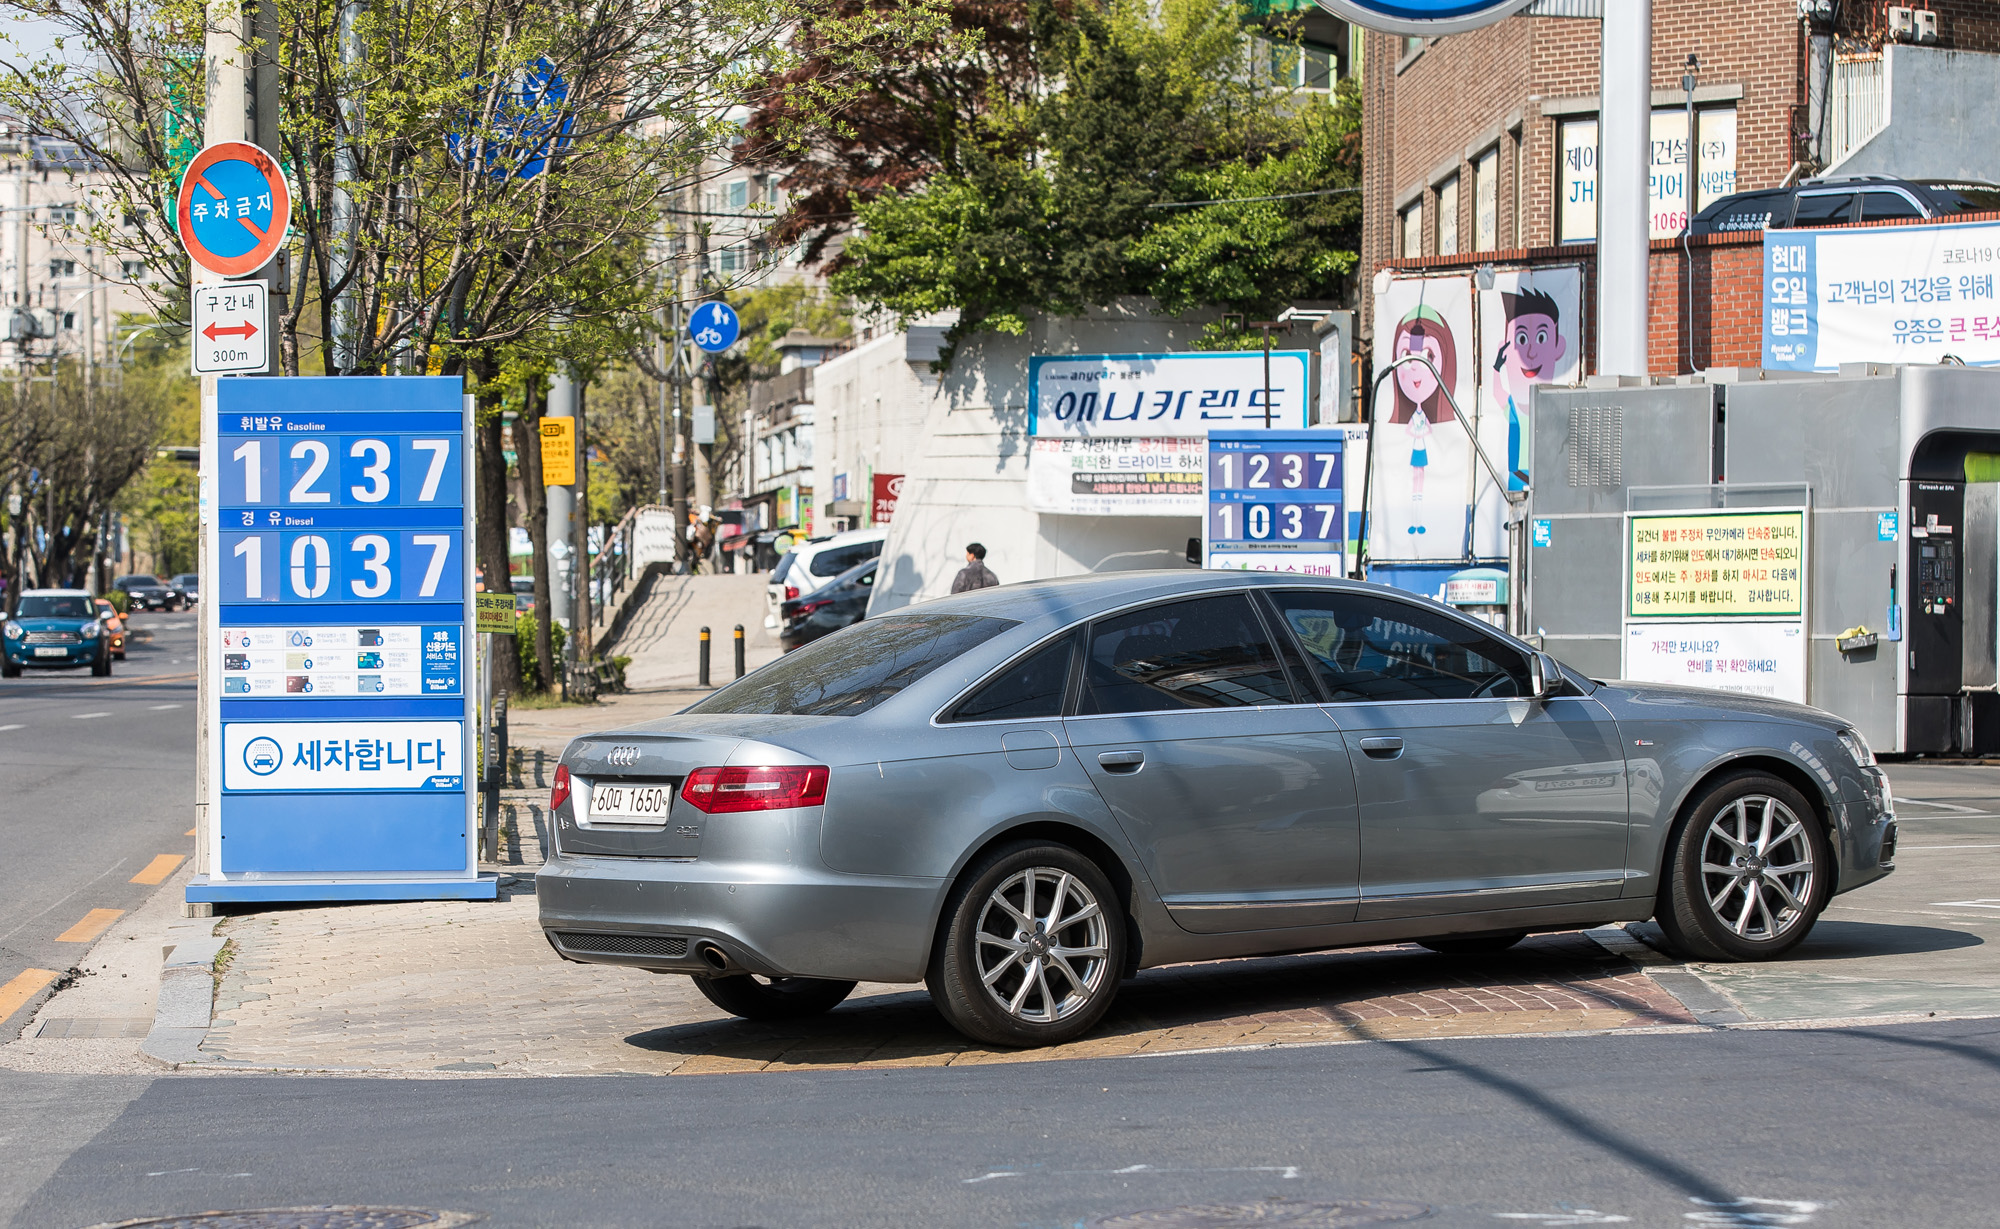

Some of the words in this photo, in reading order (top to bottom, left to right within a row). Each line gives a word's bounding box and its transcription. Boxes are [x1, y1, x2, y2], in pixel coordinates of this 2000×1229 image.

[1702, 141, 1726, 160] (주)
[1570, 180, 1594, 203] JH
[1699, 170, 1737, 195] 사업부
[193, 192, 272, 222] 주차금지
[1771, 244, 1807, 273] 현대
[1943, 247, 1992, 264] 코로나19
[1771, 277, 1808, 305] 오일
[1827, 279, 1895, 304] 고객님의
[1901, 276, 1952, 303] 건강을
[1958, 274, 1994, 300] 위해
[206, 293, 255, 312] 구간내
[1771, 308, 1808, 336] 뱅크
[1893, 318, 1944, 344] 유종은
[1949, 317, 1967, 342] 큰
[213, 350, 248, 362] 300m
[240, 416, 283, 431] 휘발유
[287, 422, 326, 431] Gasoline
[233, 439, 450, 503] 1237
[1118, 455, 1173, 469] 드라이브
[1218, 454, 1335, 488] 1237
[285, 517, 314, 527] Diesel
[1218, 504, 1335, 539] 1037
[1636, 530, 1659, 543] 길건너
[1662, 529, 1677, 542] 불법
[1680, 528, 1704, 542] 주정차
[1706, 528, 1745, 541] 무인카메라
[1747, 526, 1798, 540] 단속중입니다.
[1636, 550, 1658, 563] 세차를
[1660, 550, 1689, 563] 하기위해
[1691, 549, 1720, 562] 인도에서
[1722, 548, 1759, 561] 대기하시면
[1760, 547, 1798, 560] 단속되오니
[234, 535, 450, 599] 1037
[1636, 571, 1676, 584] 인도에서는
[1722, 569, 1739, 582] 하지
[1743, 568, 1768, 581] 마시고
[1772, 568, 1797, 581] 다음에
[1636, 591, 1660, 604] 이용해
[1663, 591, 1696, 603] 주시기를
[1700, 590, 1737, 603] 바랍니다.
[1748, 589, 1794, 602] 감사합니다.
[433, 631, 449, 641] 제휴
[426, 642, 456, 652] 신용카드
[426, 652, 443, 661] 서비스
[444, 652, 457, 661] 안내
[1651, 640, 1676, 654] 가격만
[1679, 640, 1720, 653] 보시나요?
[1687, 659, 1713, 673] 연비를
[1715, 659, 1727, 673] 꼭!
[1730, 659, 1776, 673] 확인하세요!
[292, 738, 446, 772] 세차합니다
[598, 788, 622, 811] 60다
[630, 788, 662, 812] 1650
